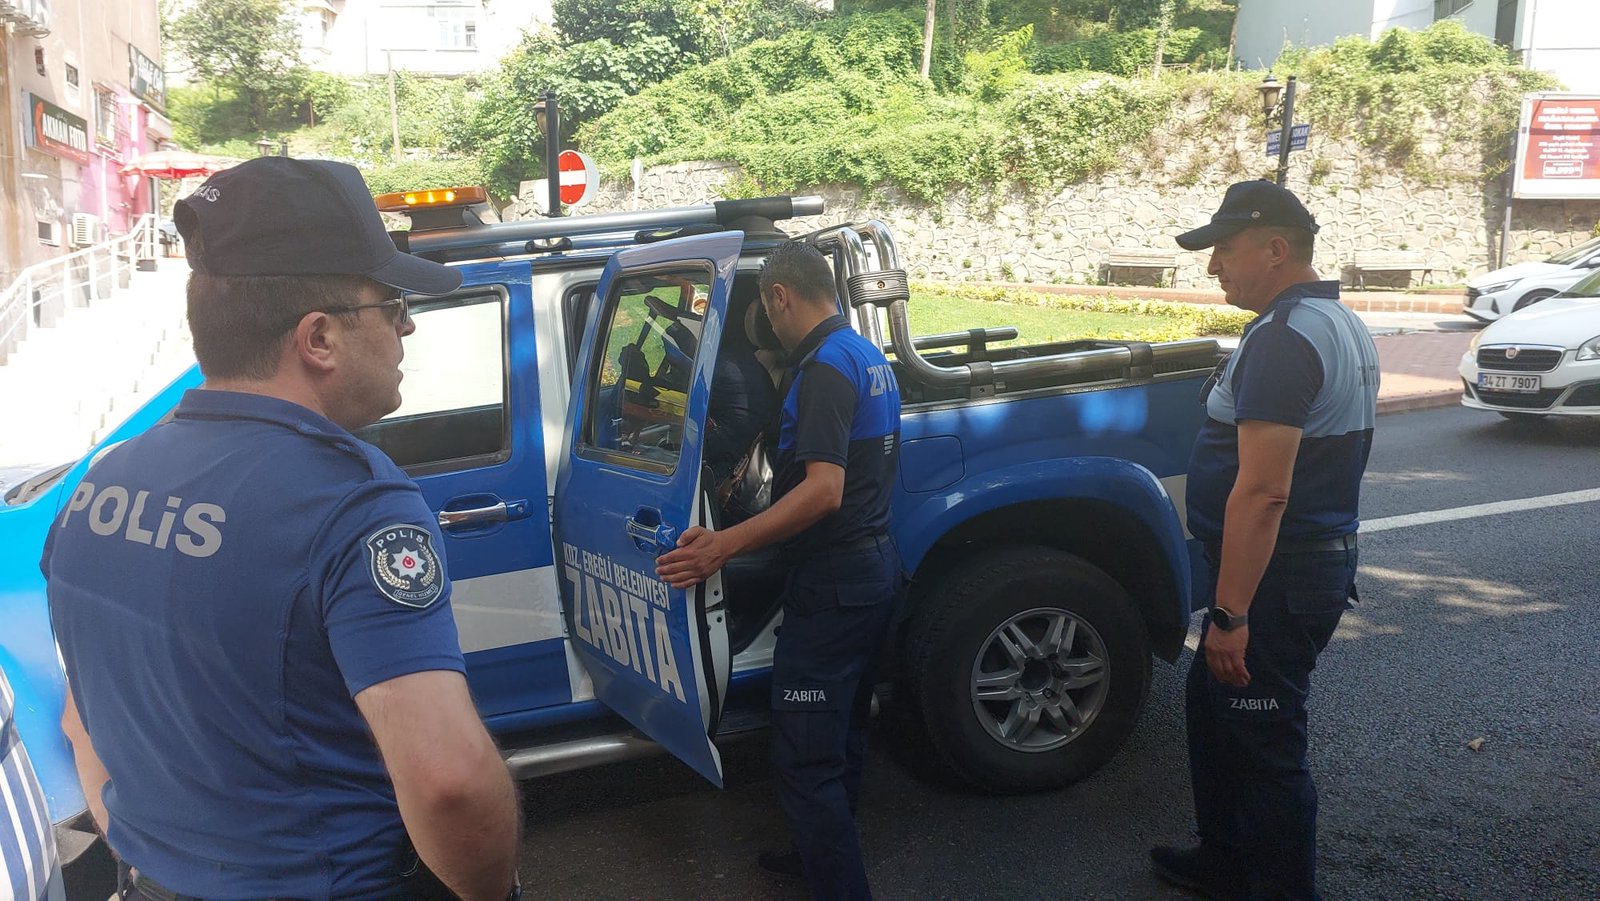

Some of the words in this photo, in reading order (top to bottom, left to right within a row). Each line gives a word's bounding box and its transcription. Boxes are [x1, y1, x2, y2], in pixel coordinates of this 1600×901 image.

[43, 112, 69, 145] AKMAN
[68, 125, 87, 153] FOTO
[1483, 375, 1493, 386] 34
[1495, 376, 1507, 388] ZT
[1511, 377, 1538, 389] 7907
[563, 542, 581, 570] KDZ.
[582, 549, 613, 584] EREĞLİ
[613, 563, 670, 610] BELEDİYESİ
[565, 565, 687, 704] ZABITA
[783, 689, 827, 702] ZABITA
[1229, 698, 1280, 710] ZABITA
